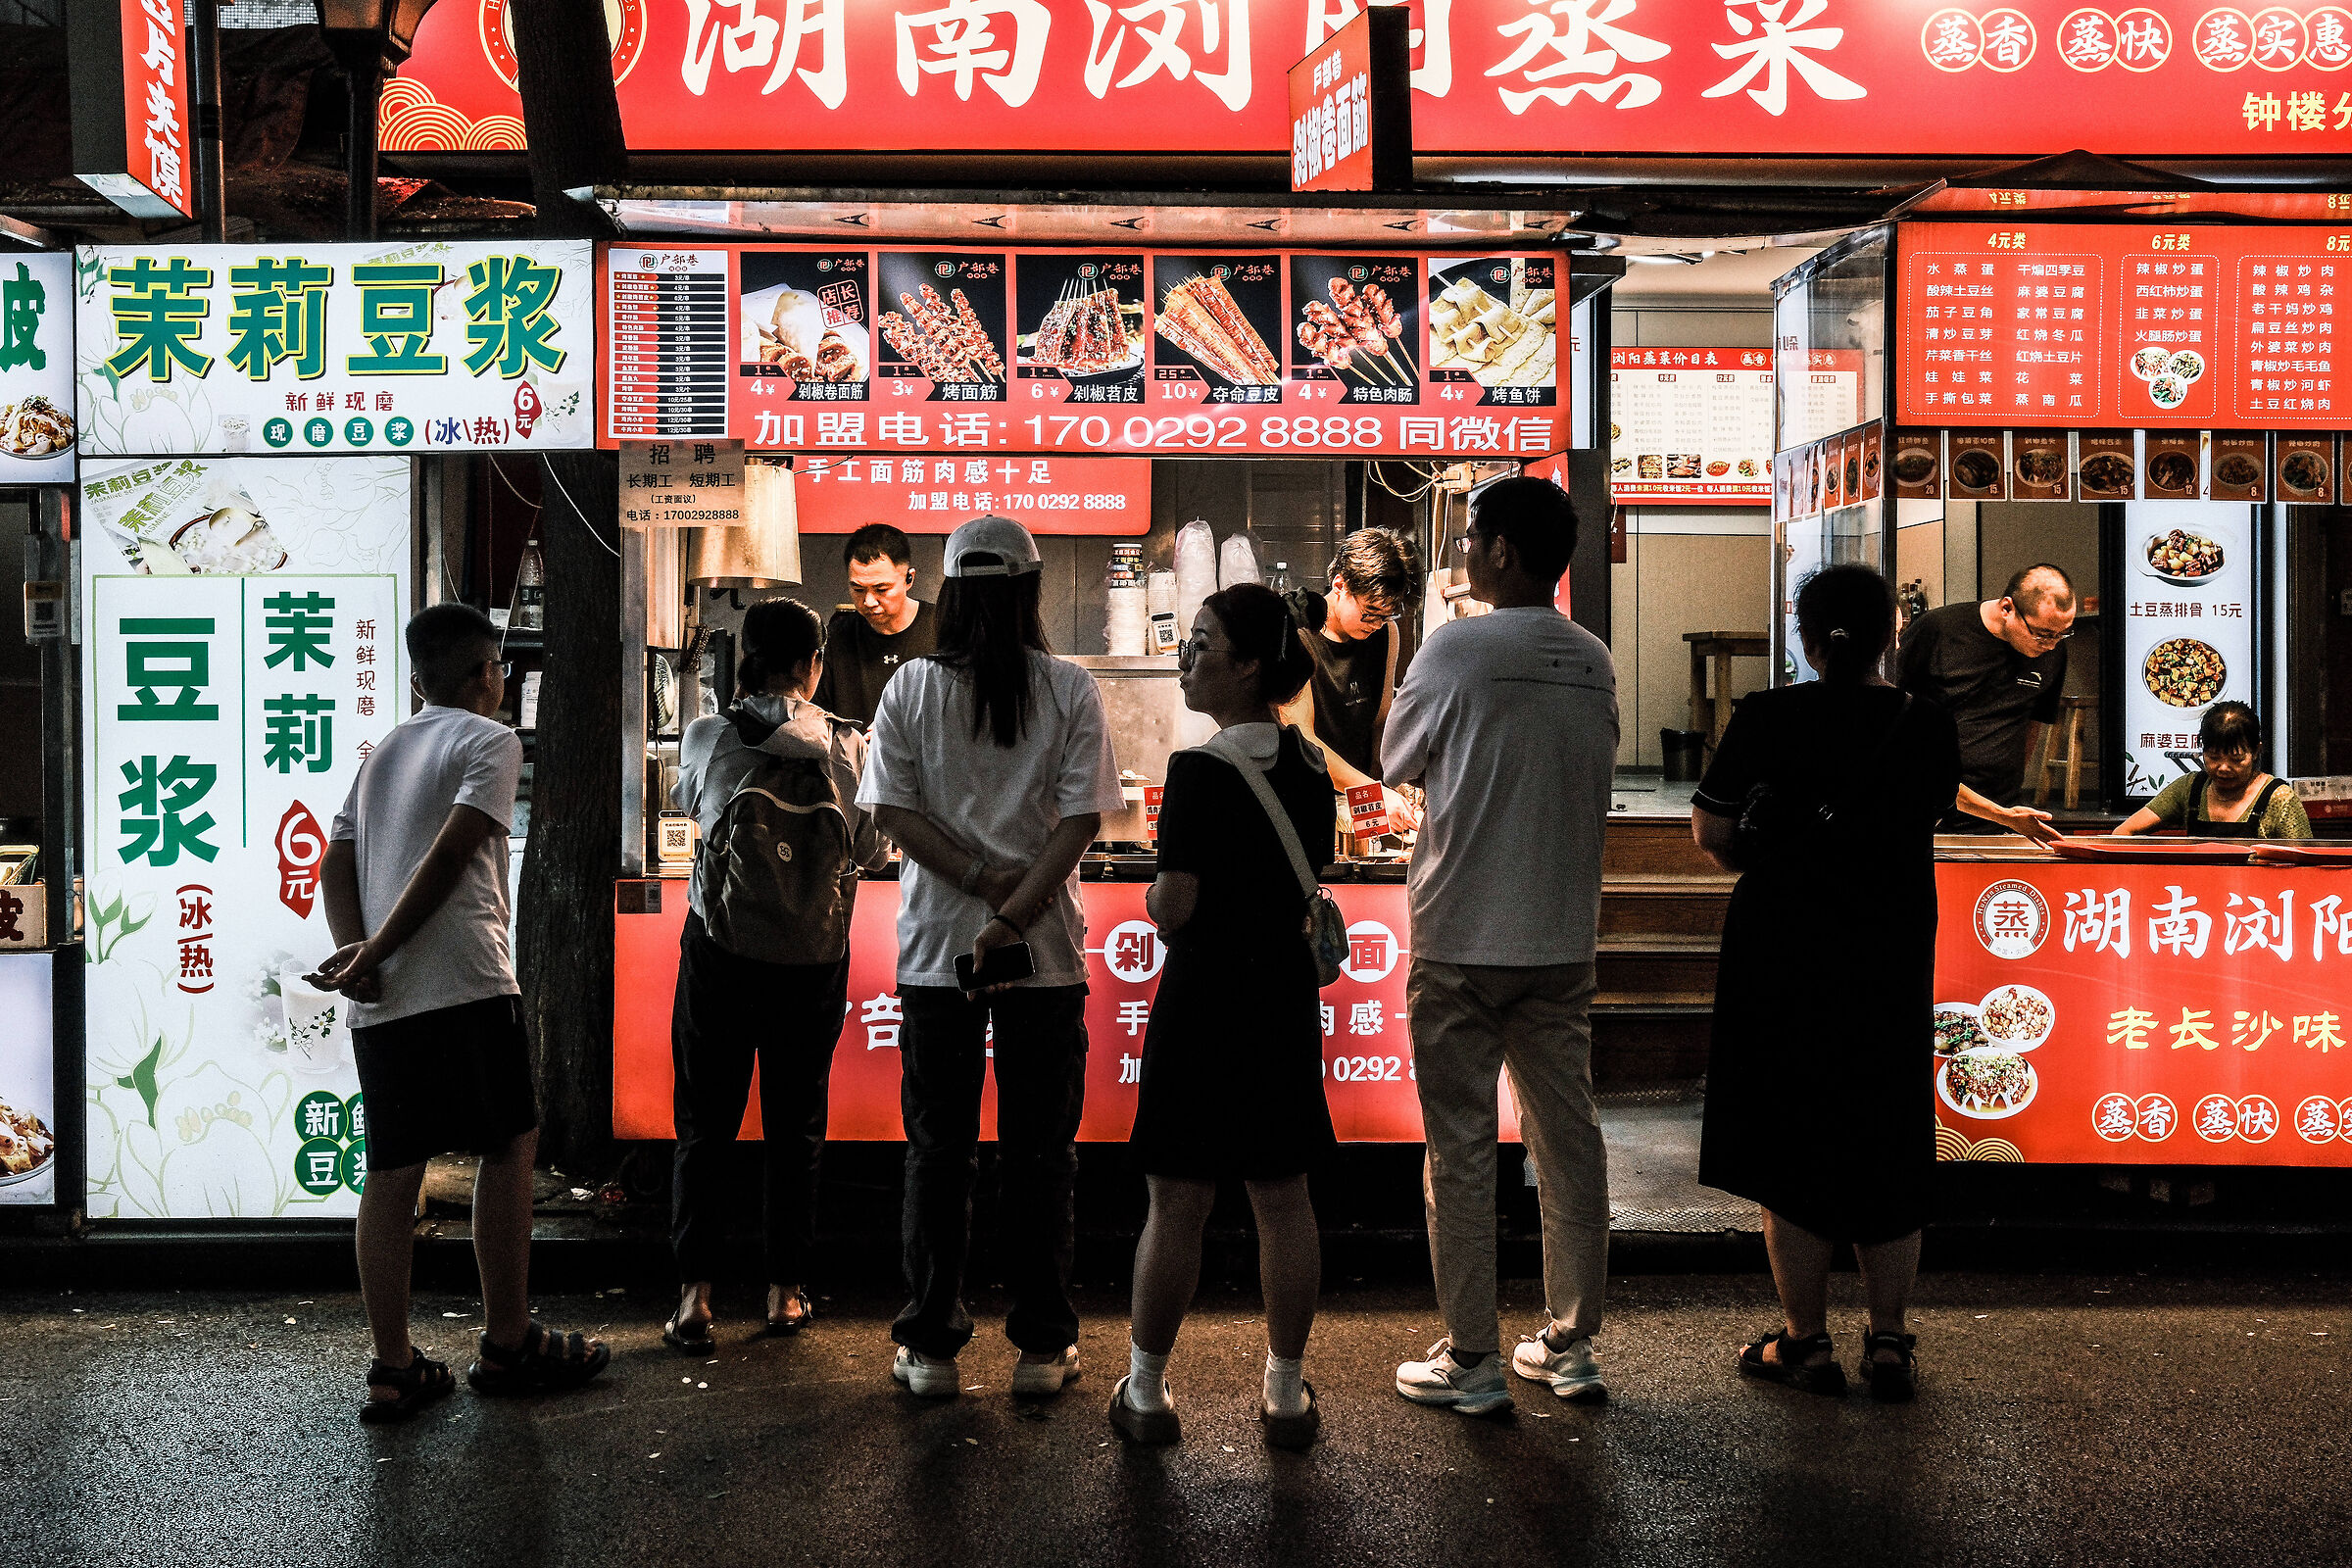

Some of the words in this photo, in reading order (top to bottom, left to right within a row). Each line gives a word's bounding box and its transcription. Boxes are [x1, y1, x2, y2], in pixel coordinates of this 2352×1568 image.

[1932, 16, 2029, 65] 蒸香
[2066, 16, 2166, 64] 蒸快
[2201, 15, 2352, 64] 蒸实惠
[1987, 232, 2026, 250] 4元类
[2151, 233, 2190, 251] 6元类
[2326, 235, 2351, 251] 8元
[661, 254, 699, 266] 户部巷
[958, 262, 1000, 273] 户部巷
[1101, 264, 1142, 274] 户部巷
[1234, 265, 1274, 274] 户部巷
[1371, 266, 1411, 276] 户部巷
[1927, 263, 1994, 276] 水蒸蛋
[2018, 264, 2084, 276] 干煸四季豆
[2136, 262, 2204, 275] 辣椒炒蛋
[2253, 265, 2333, 277] 辣椒炒肉
[821, 283, 858, 306] 店长
[1926, 284, 1993, 298] 酸辣土豆丝
[2017, 285, 2084, 299] 麻婆豆腐
[2135, 284, 2203, 298] 西红柿炒蛋
[2253, 284, 2333, 296] 酸辣鸡杂
[826, 305, 861, 325] 推荐
[1926, 306, 1993, 319] 茄子豆角
[2017, 307, 2083, 320] 家常豆腐
[2135, 307, 2202, 320] 韭菜炒蛋
[2252, 303, 2332, 315] 老干妈炒鸡
[0, 261, 46, 373] 皮
[105, 254, 567, 382] 茉莉豆浆
[1926, 327, 1992, 341] 清炒豆芽
[2016, 328, 2083, 342] 红烧冬瓜
[2251, 321, 2332, 334] 扁豆丝炒肉
[2134, 329, 2202, 343] 火腿肠炒蛋
[2251, 341, 2331, 353] 外婆菜炒肉
[1612, 351, 1719, 367] 浏阳蒸菜价目表
[1925, 348, 1992, 363] 芹菜香干丝
[2015, 350, 2082, 363] 红烧土豆片
[2250, 360, 2330, 372] 青椒炒毛毛鱼
[1925, 370, 1991, 384] 娃娃菜
[2015, 371, 2082, 385] 花菜
[799, 383, 863, 400] 剁椒卷面筋
[943, 384, 998, 401] 烤面筋
[2250, 379, 2330, 391] 青椒炒河虾
[1074, 385, 1138, 402] 剁椒苕皮
[1213, 385, 1279, 402] 夺命豆皮
[1353, 387, 1412, 402] 特色肉肠
[1493, 387, 1541, 403] 烤鱼饼
[1925, 392, 1991, 406] 手撕包菜
[2015, 393, 2082, 407] 蒸南瓜
[284, 390, 395, 413] 新鲜现磨
[2250, 399, 2330, 411] 土豆红烧肉
[270, 421, 409, 444] 现磨豆浆
[754, 411, 1007, 447] 加盟电话:
[1024, 415, 1110, 447] 170
[1124, 416, 1248, 448] 0292
[1259, 416, 1383, 448] 8888
[1399, 416, 1553, 451] 同微信
[649, 443, 715, 465] 招聘
[806, 459, 1053, 484] 手工面筋肉感十足
[627, 473, 673, 488] 长期工
[689, 473, 736, 488] 短期工
[1036, 493, 1080, 511] 0292
[1083, 493, 1126, 511] 8888
[2130, 602, 2203, 618] 土豆蒸排骨
[2212, 603, 2243, 618] 15元
[356, 618, 376, 716] 新鲜现磨
[263, 591, 336, 774] 茉莉
[117, 617, 220, 867] 豆浆
[1366, 819, 1379, 828] 6元
[282, 811, 321, 900] 6元
[1993, 901, 2030, 938] 蒸
[1114, 931, 1155, 973] 剁
[1348, 933, 1389, 972] 面
[2106, 1005, 2346, 1054] 老长沙味
[1333, 1055, 1401, 1082] 0292
[2099, 1099, 2173, 1137] 蒸香
[2199, 1100, 2276, 1137] 蒸快
